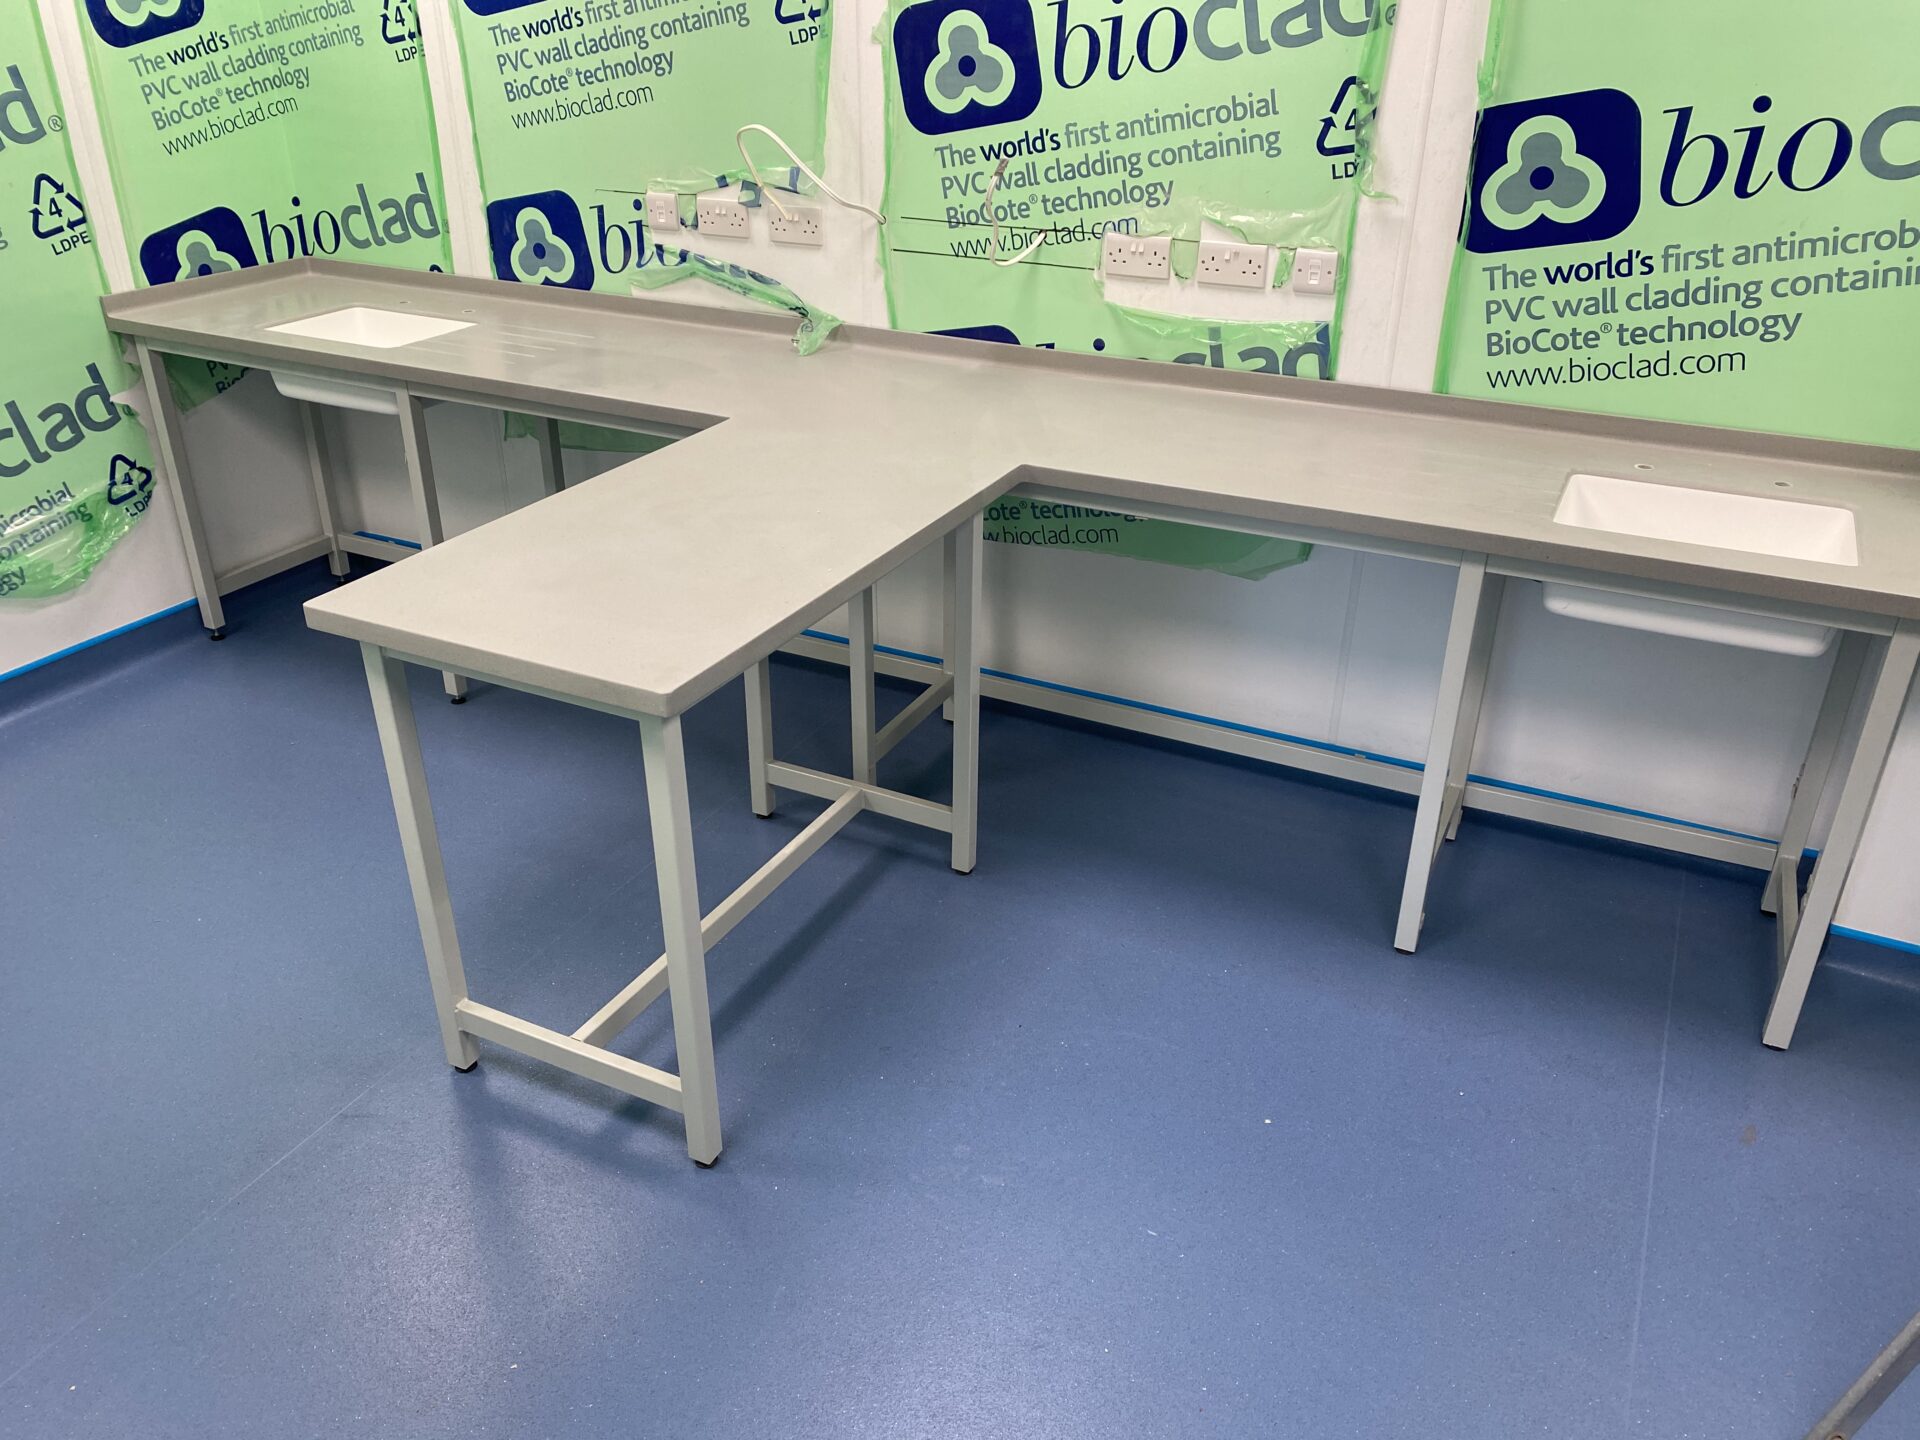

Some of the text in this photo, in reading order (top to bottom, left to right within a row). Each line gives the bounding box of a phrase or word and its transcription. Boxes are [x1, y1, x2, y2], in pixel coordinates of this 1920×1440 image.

[128, 0, 355, 77] The world's first antimicrobial
[488, 23, 521, 47] The
[522, 6, 584, 39] world's
[585, 0, 621, 24] first
[497, 48, 533, 75] PVC
[534, 37, 573, 66] wall
[574, 25, 649, 57] cladding
[651, 1, 750, 39] containing
[140, 24, 364, 104] PVC wall cladding containing
[226, 66, 310, 104] technology
[575, 51, 673, 87] technology
[162, 97, 298, 156] www.bioclad.com
[511, 86, 654, 129] www.bioclad.com
[935, 88, 1279, 168] The world's first antimicrobial
[941, 172, 987, 199] PVC
[1044, 149, 1143, 183] cladding
[1148, 128, 1281, 167] containing
[48, 197, 62, 217] 4
[251, 172, 440, 264] bioclad
[1042, 179, 1174, 216] technology
[51, 231, 92, 255] LDPE
[1482, 263, 1537, 291] The
[1543, 249, 1654, 284] world's
[1661, 244, 1724, 273] first
[1486, 256, 1920, 324] PVC wall cladding containi
[1617, 310, 1802, 346] technology
[1486, 350, 1746, 388] www.bioclad.com
